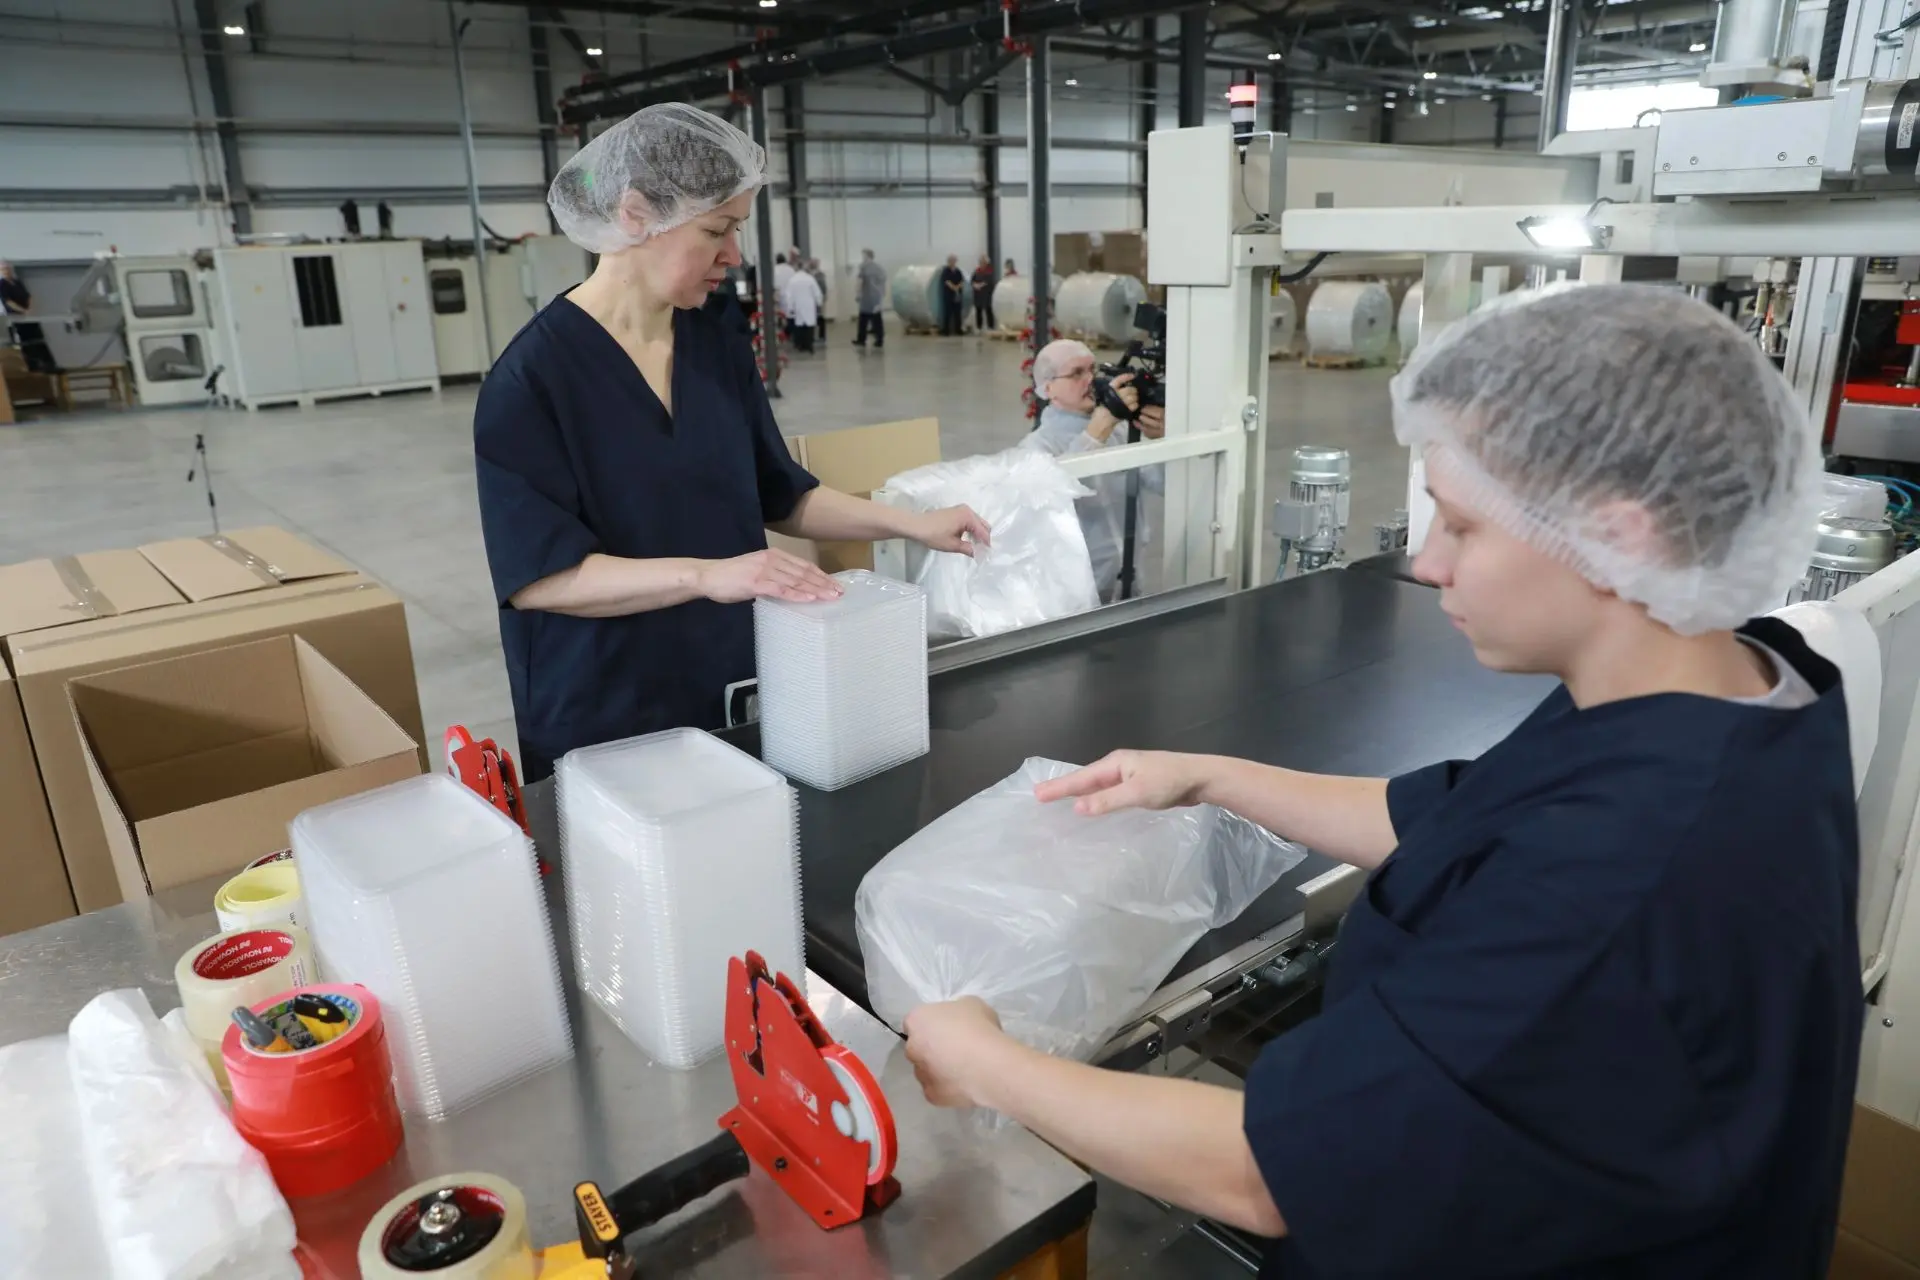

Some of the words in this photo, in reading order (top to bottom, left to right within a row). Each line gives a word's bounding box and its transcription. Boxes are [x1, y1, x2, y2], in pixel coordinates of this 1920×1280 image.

[220, 949, 262, 972] NOVAROLL
[242, 956, 282, 971] NOVAROLL
[583, 1192, 612, 1232] STAYER
